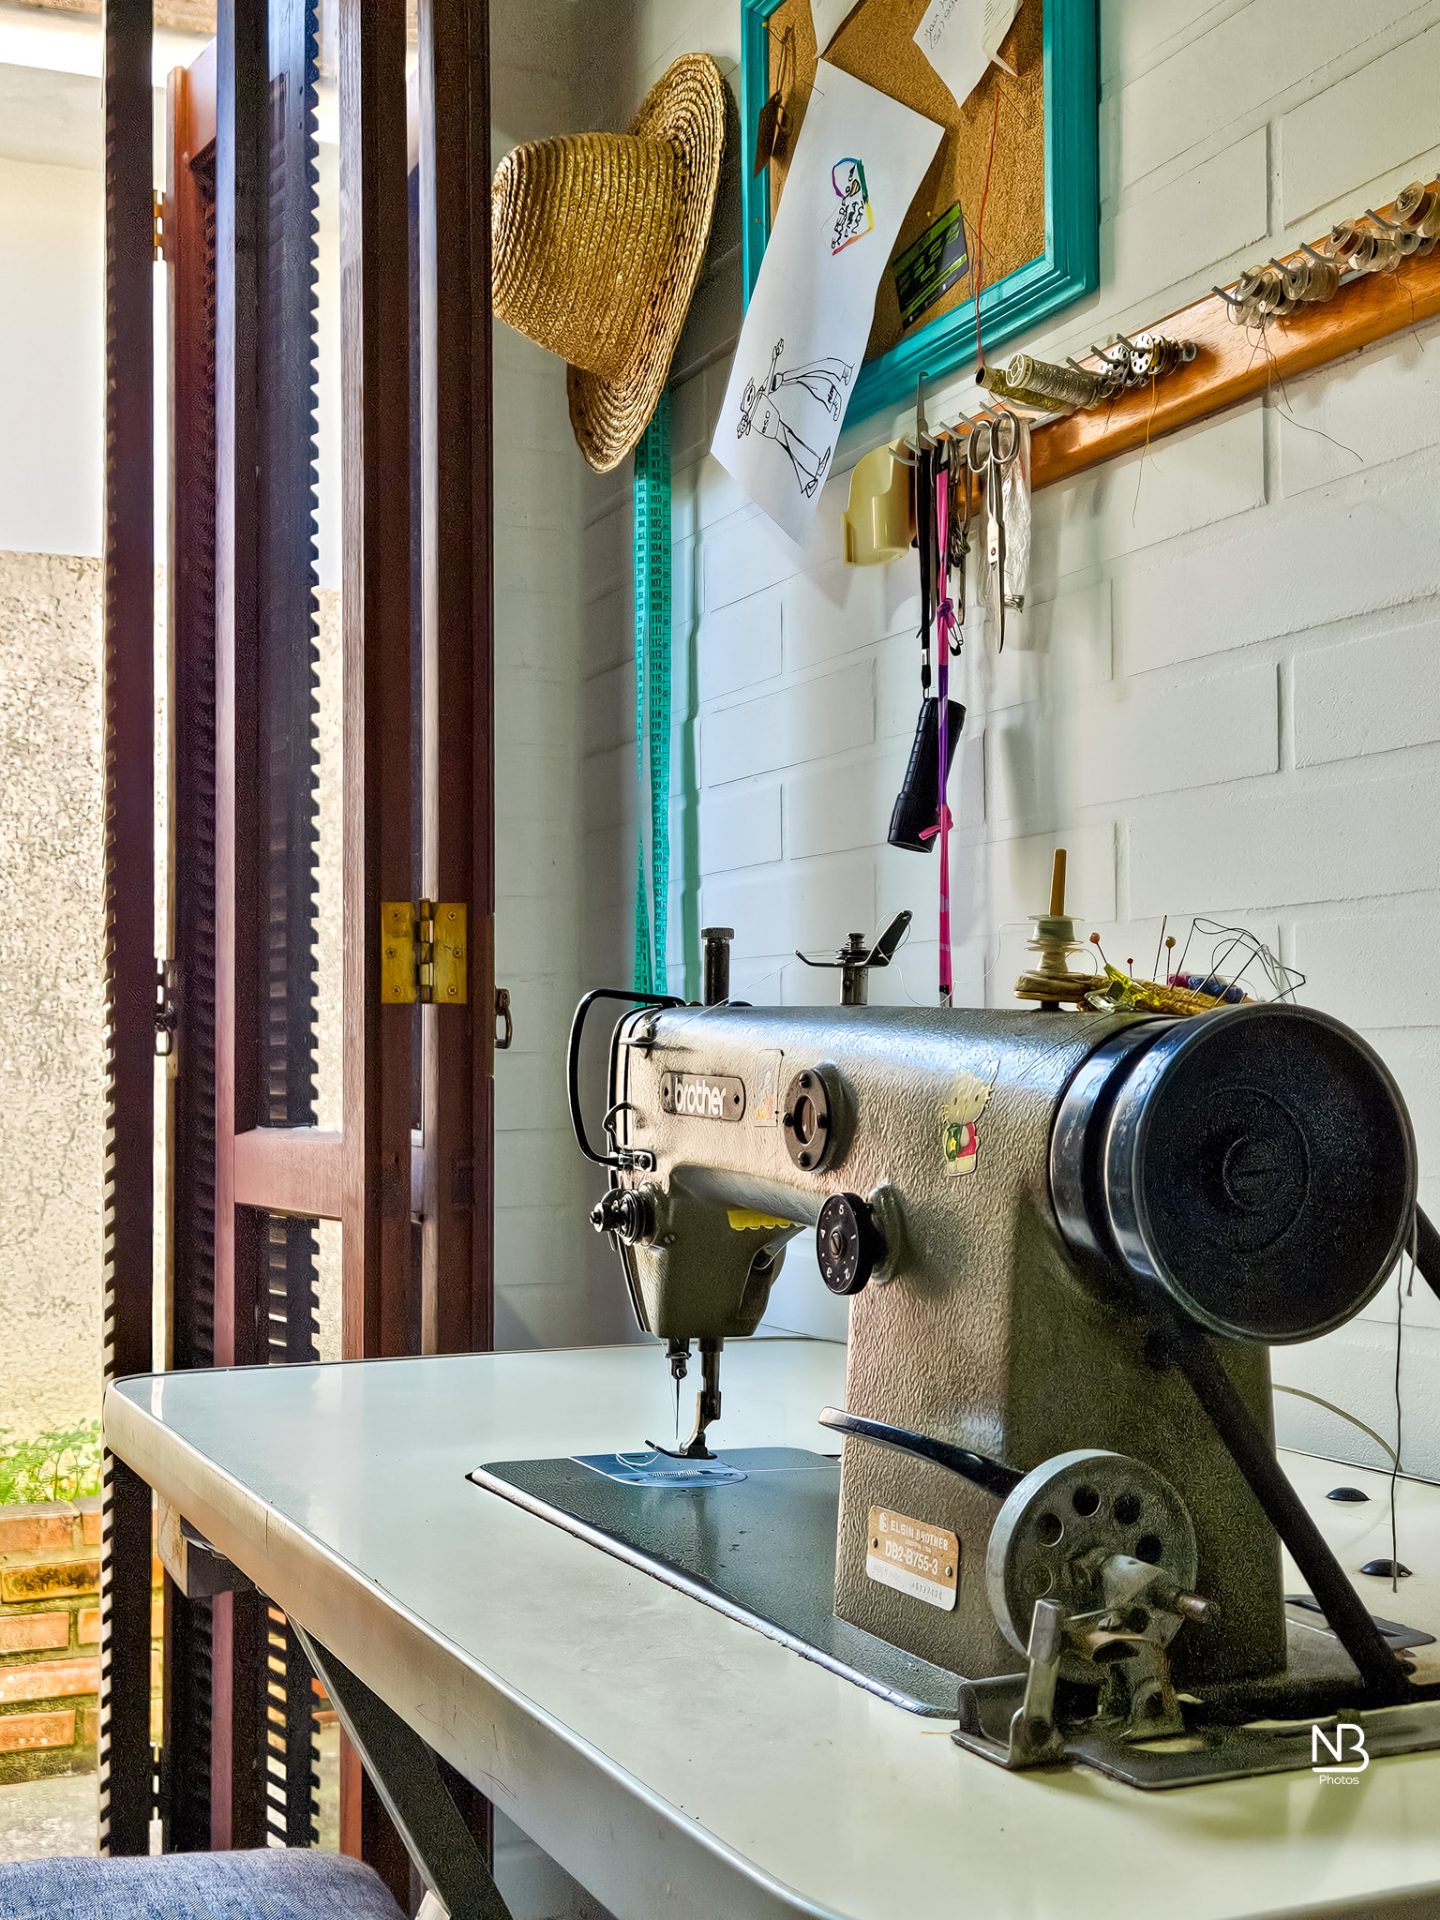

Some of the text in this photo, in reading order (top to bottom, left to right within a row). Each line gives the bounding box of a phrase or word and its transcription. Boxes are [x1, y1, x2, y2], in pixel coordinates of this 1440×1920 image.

[651, 494, 662, 503] 100
[651, 506, 662, 516] 101
[651, 518, 662, 528] 102
[651, 531, 662, 540] 103
[651, 543, 662, 551] 104
[651, 554, 662, 563] 105
[651, 566, 662, 575] 106
[651, 578, 662, 587] 107
[651, 590, 662, 599] 108
[651, 602, 662, 611] 109
[652, 614, 662, 623] 110
[652, 626, 662, 635] 111
[652, 638, 662, 647] 112
[652, 650, 662, 658] 113
[652, 662, 662, 670] 114
[652, 673, 662, 682] 115
[652, 685, 662, 694] 116
[652, 697, 662, 706] 117
[652, 709, 662, 718] 118
[652, 721, 662, 730] 119
[652, 733, 662, 742] 120
[675, 1077, 727, 1116] brother
[890, 1519, 914, 1539] ELGIN
